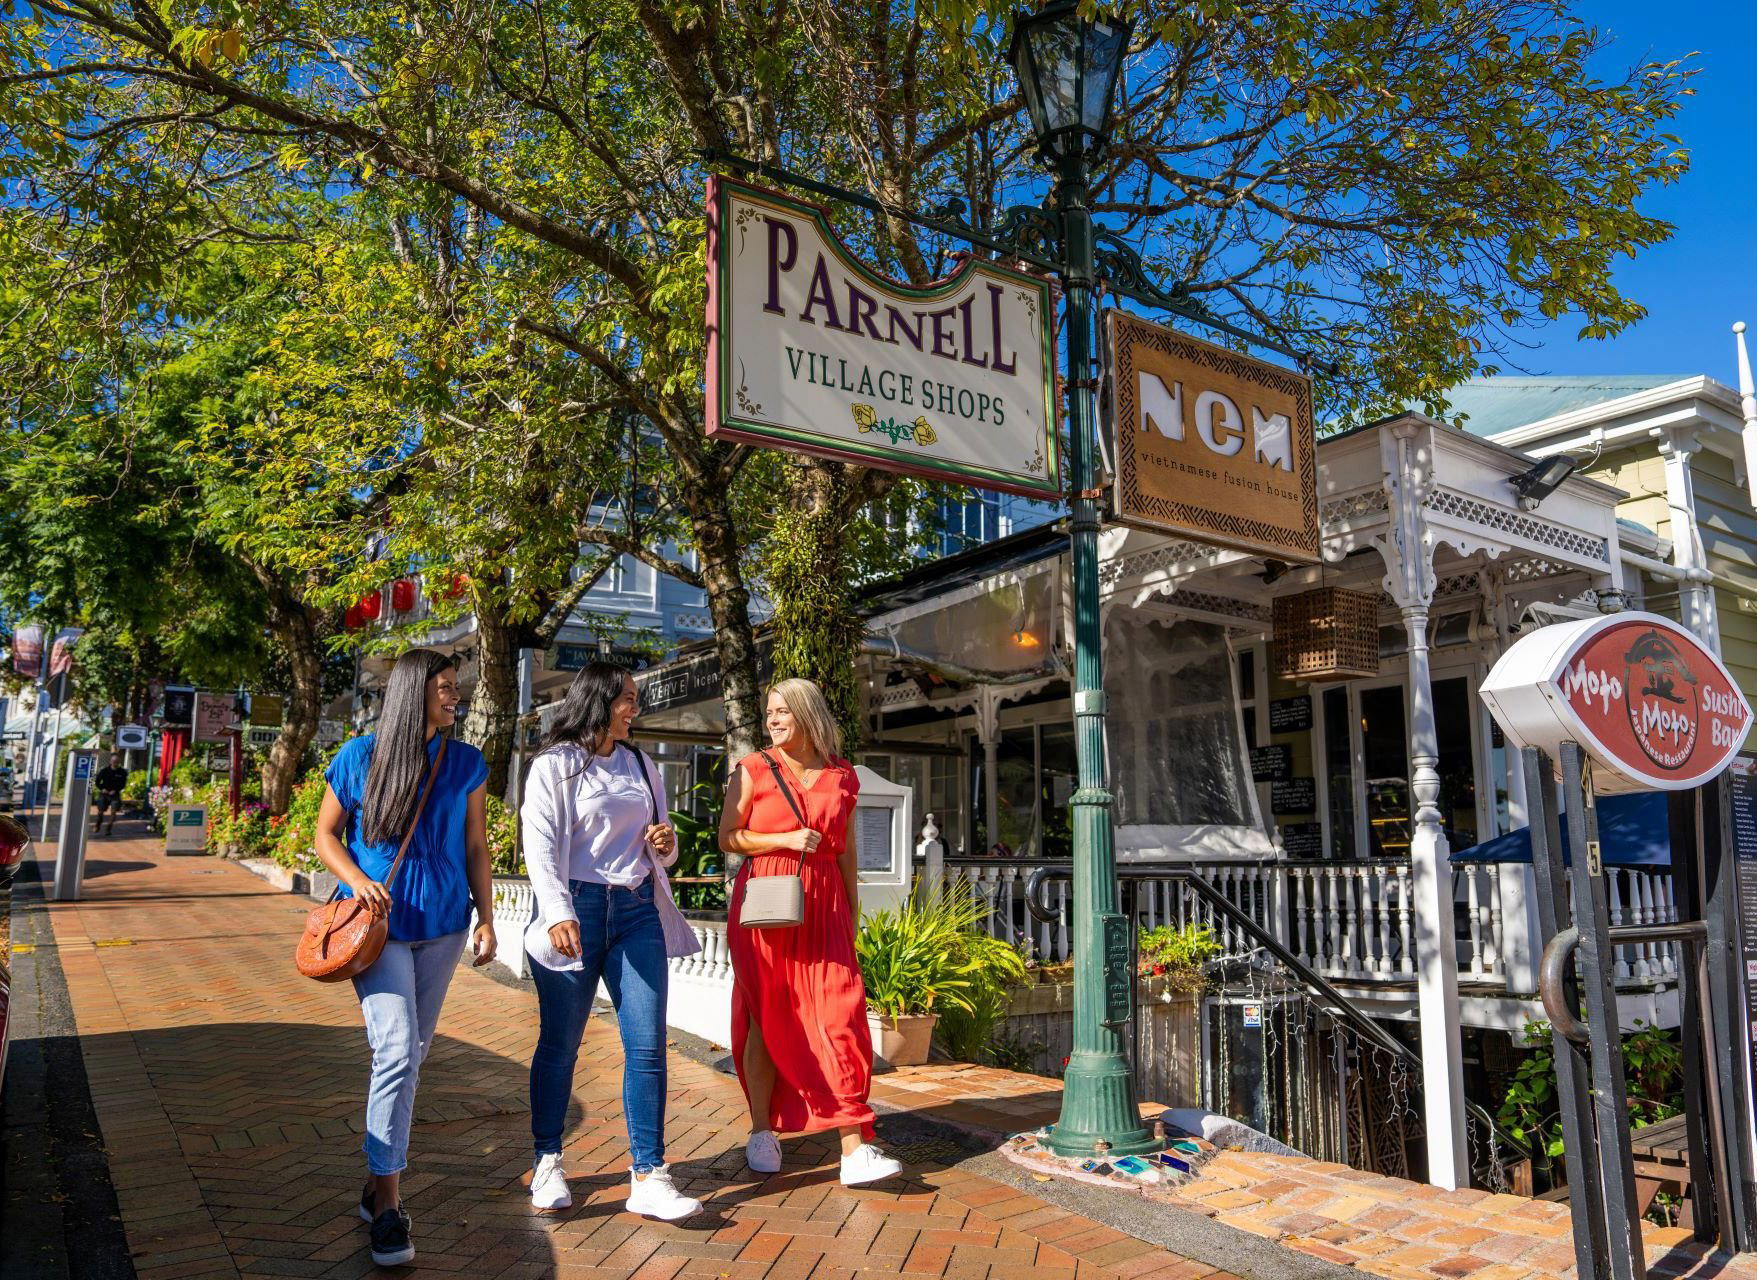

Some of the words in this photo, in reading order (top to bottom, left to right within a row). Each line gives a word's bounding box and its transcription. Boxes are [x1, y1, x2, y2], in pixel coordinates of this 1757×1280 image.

[762, 214, 1018, 377] PARNELL
[785, 346, 915, 406] VILLAGE
[921, 379, 1005, 427] SHOPS
[1141, 452, 1218, 481] vietnamese
[1224, 471, 1261, 493] fusion
[1266, 481, 1300, 502] house
[573, 650, 598, 662] JAVA
[651, 679, 685, 700] VERVE
[1702, 685, 1743, 720] Sushi
[1711, 717, 1740, 748] Bar
[78, 757, 89, 769] P
[1589, 844, 1598, 874] 5
